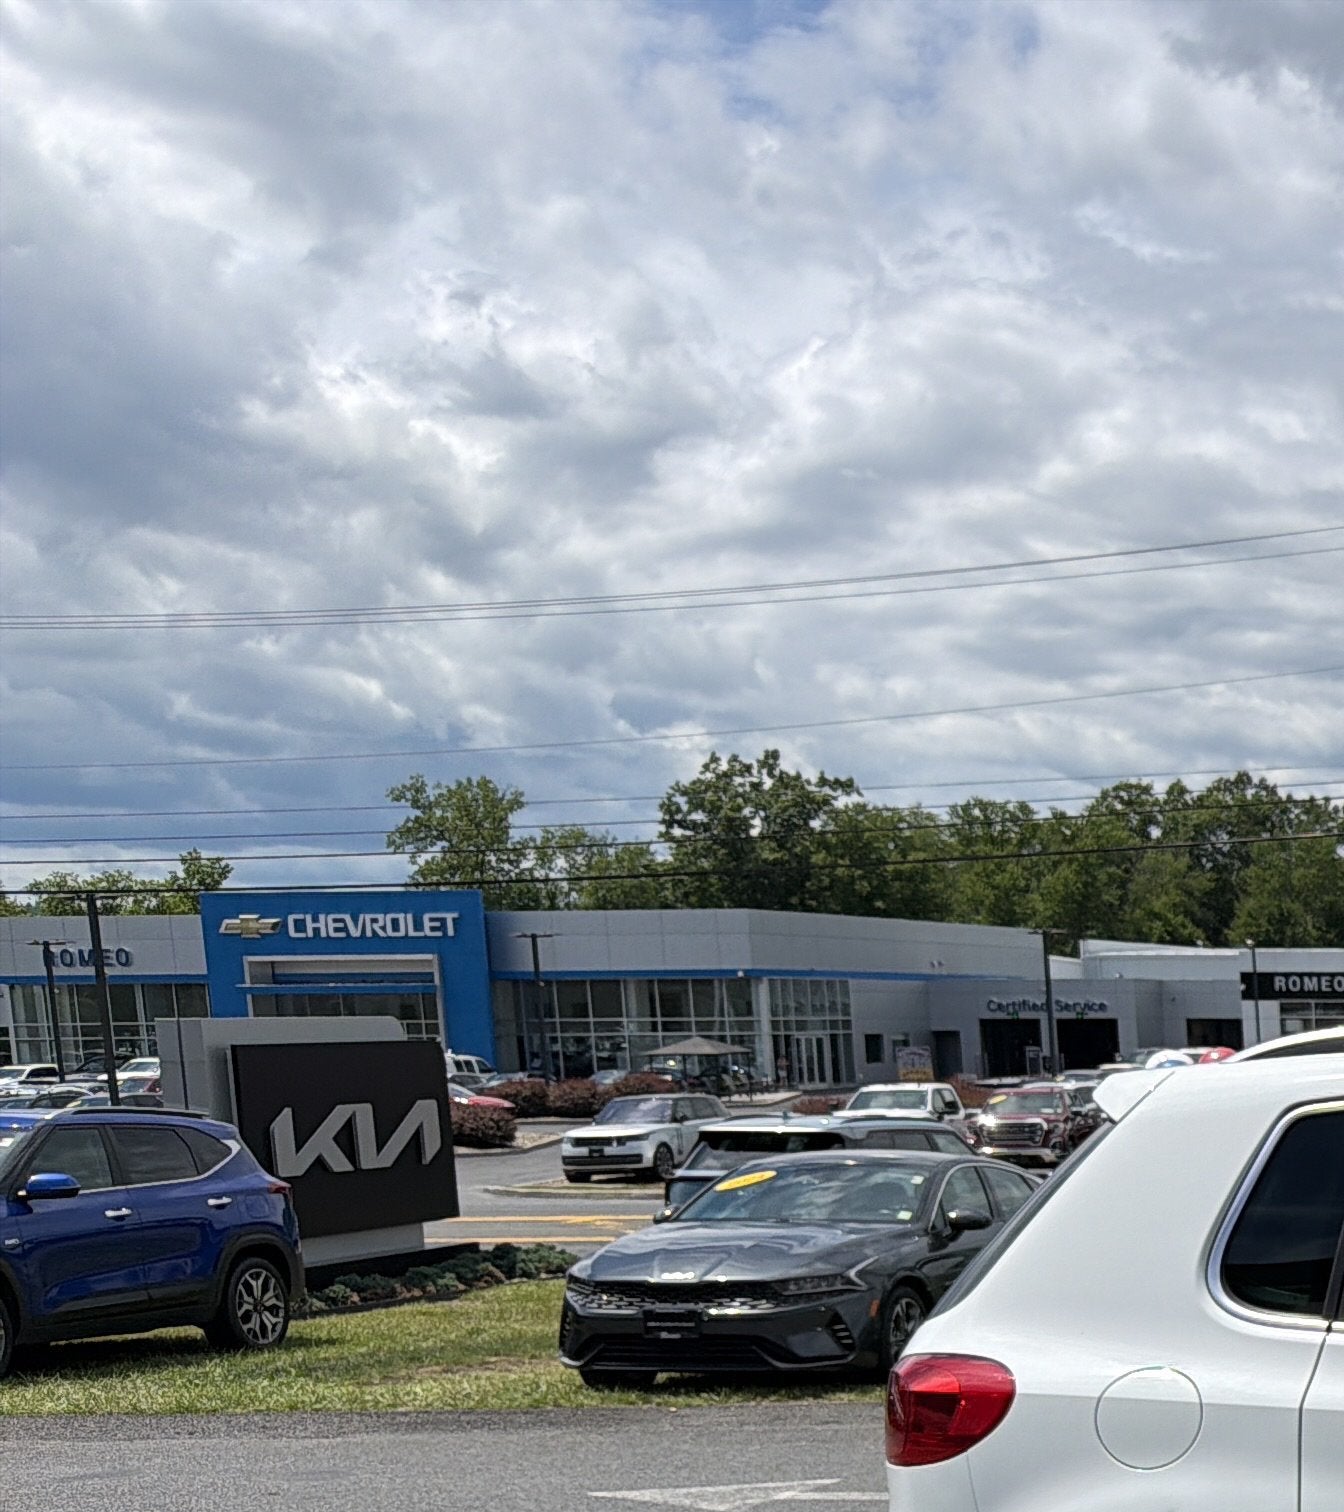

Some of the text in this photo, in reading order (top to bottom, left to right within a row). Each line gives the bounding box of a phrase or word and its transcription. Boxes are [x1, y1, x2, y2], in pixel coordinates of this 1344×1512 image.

[287, 912, 459, 938] CHEVROLET
[1054, 999, 1108, 1013] Service
[270, 1099, 441, 1178] KIA
